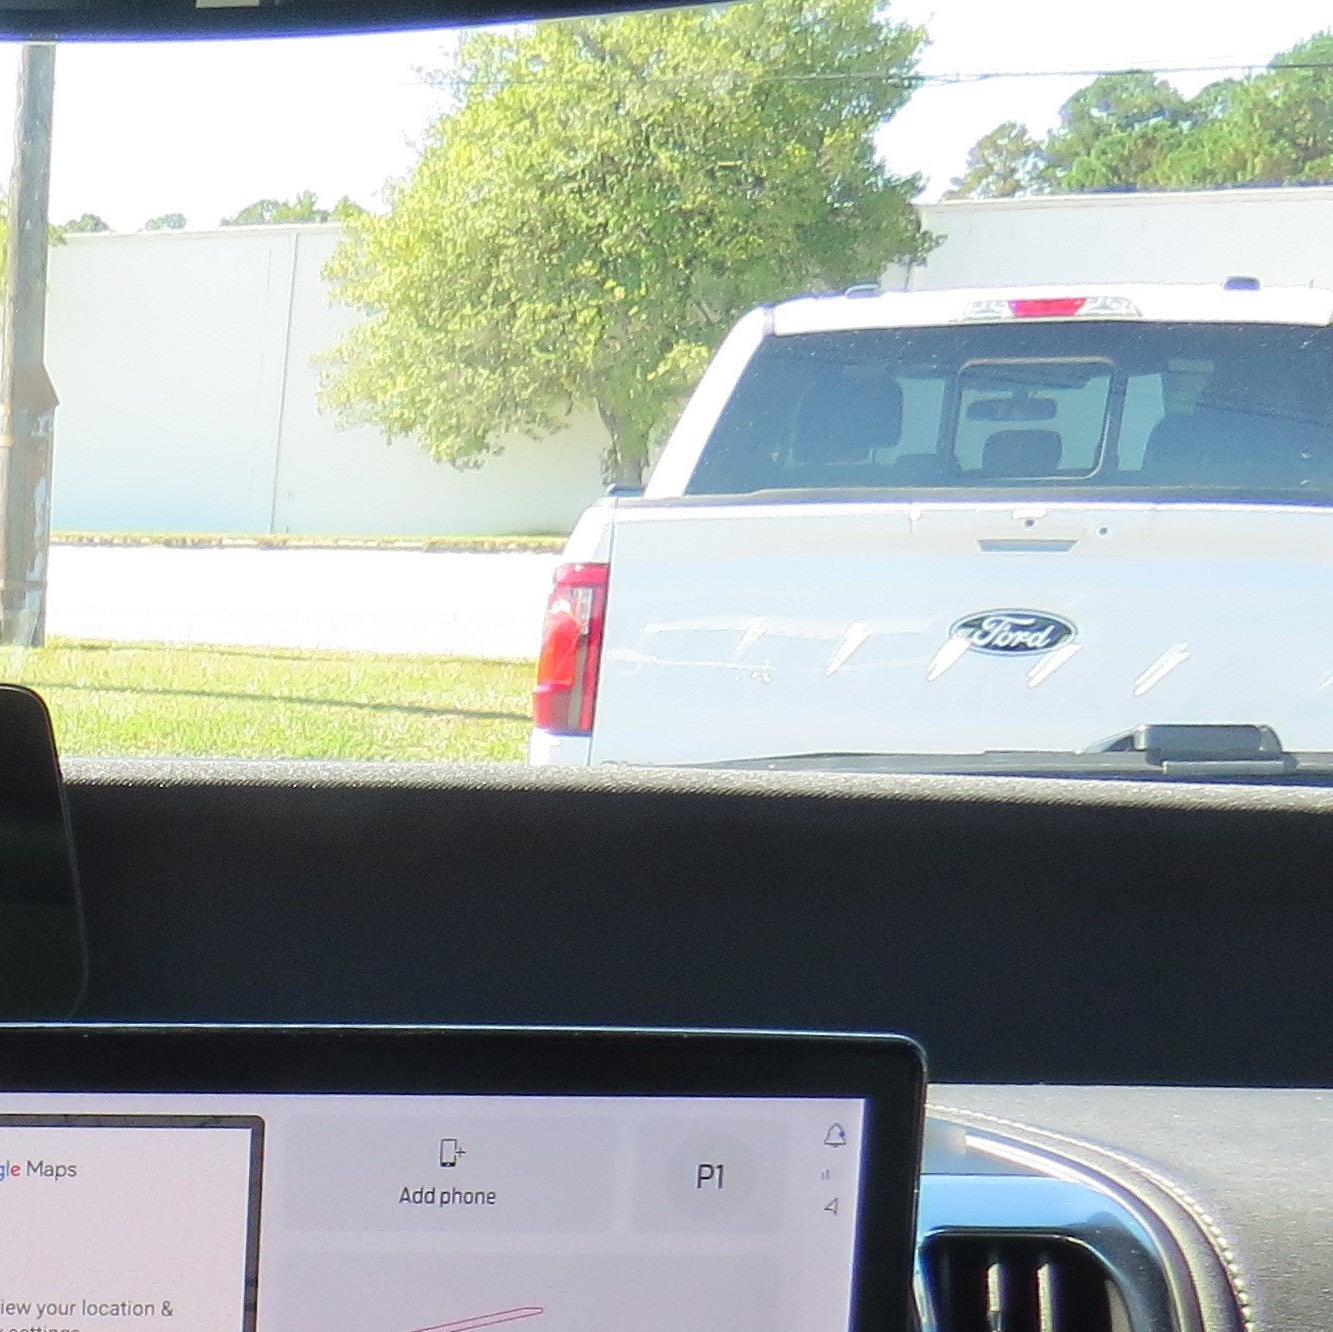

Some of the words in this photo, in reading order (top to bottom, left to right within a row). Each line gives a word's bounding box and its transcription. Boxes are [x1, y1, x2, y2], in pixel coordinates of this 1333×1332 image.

[26, 1158, 77, 1181] Maps
[696, 1163, 725, 1190] P1
[398, 1186, 436, 1206] Add
[439, 1186, 497, 1208] phone
[36, 1301, 77, 1320] your
[81, 1298, 155, 1317] location
[160, 1299, 174, 1317] &
